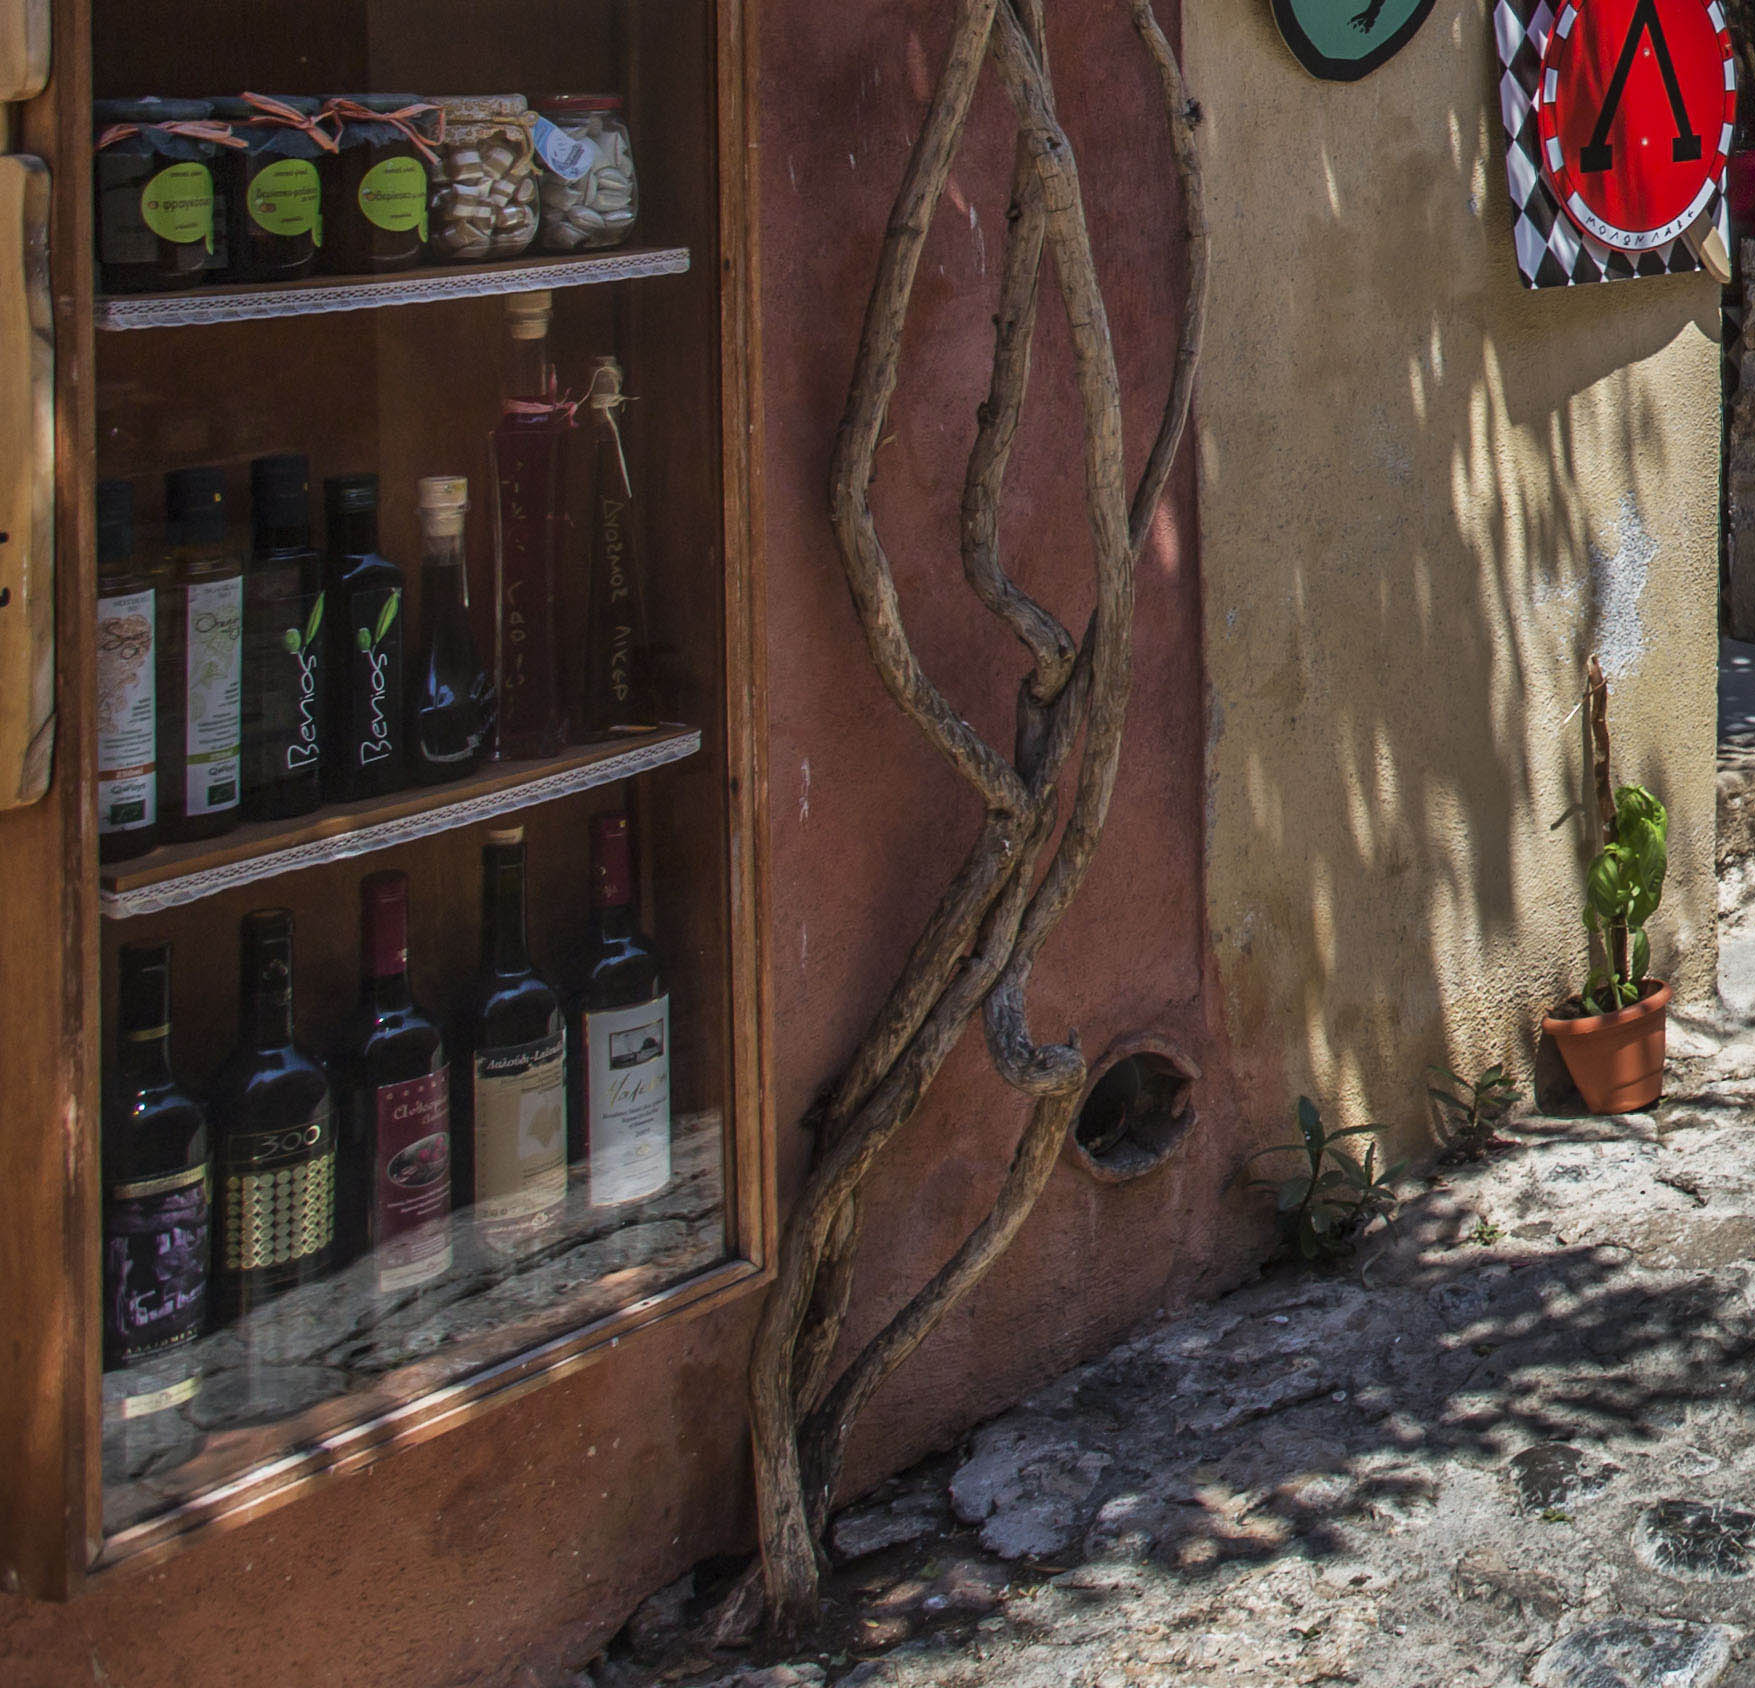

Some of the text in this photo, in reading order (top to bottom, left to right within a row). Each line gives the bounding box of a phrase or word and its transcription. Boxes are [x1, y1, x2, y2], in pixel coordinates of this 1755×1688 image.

[287, 648, 320, 769] Benios
[360, 649, 392, 764] Benios
[252, 1125, 322, 1161] 300
